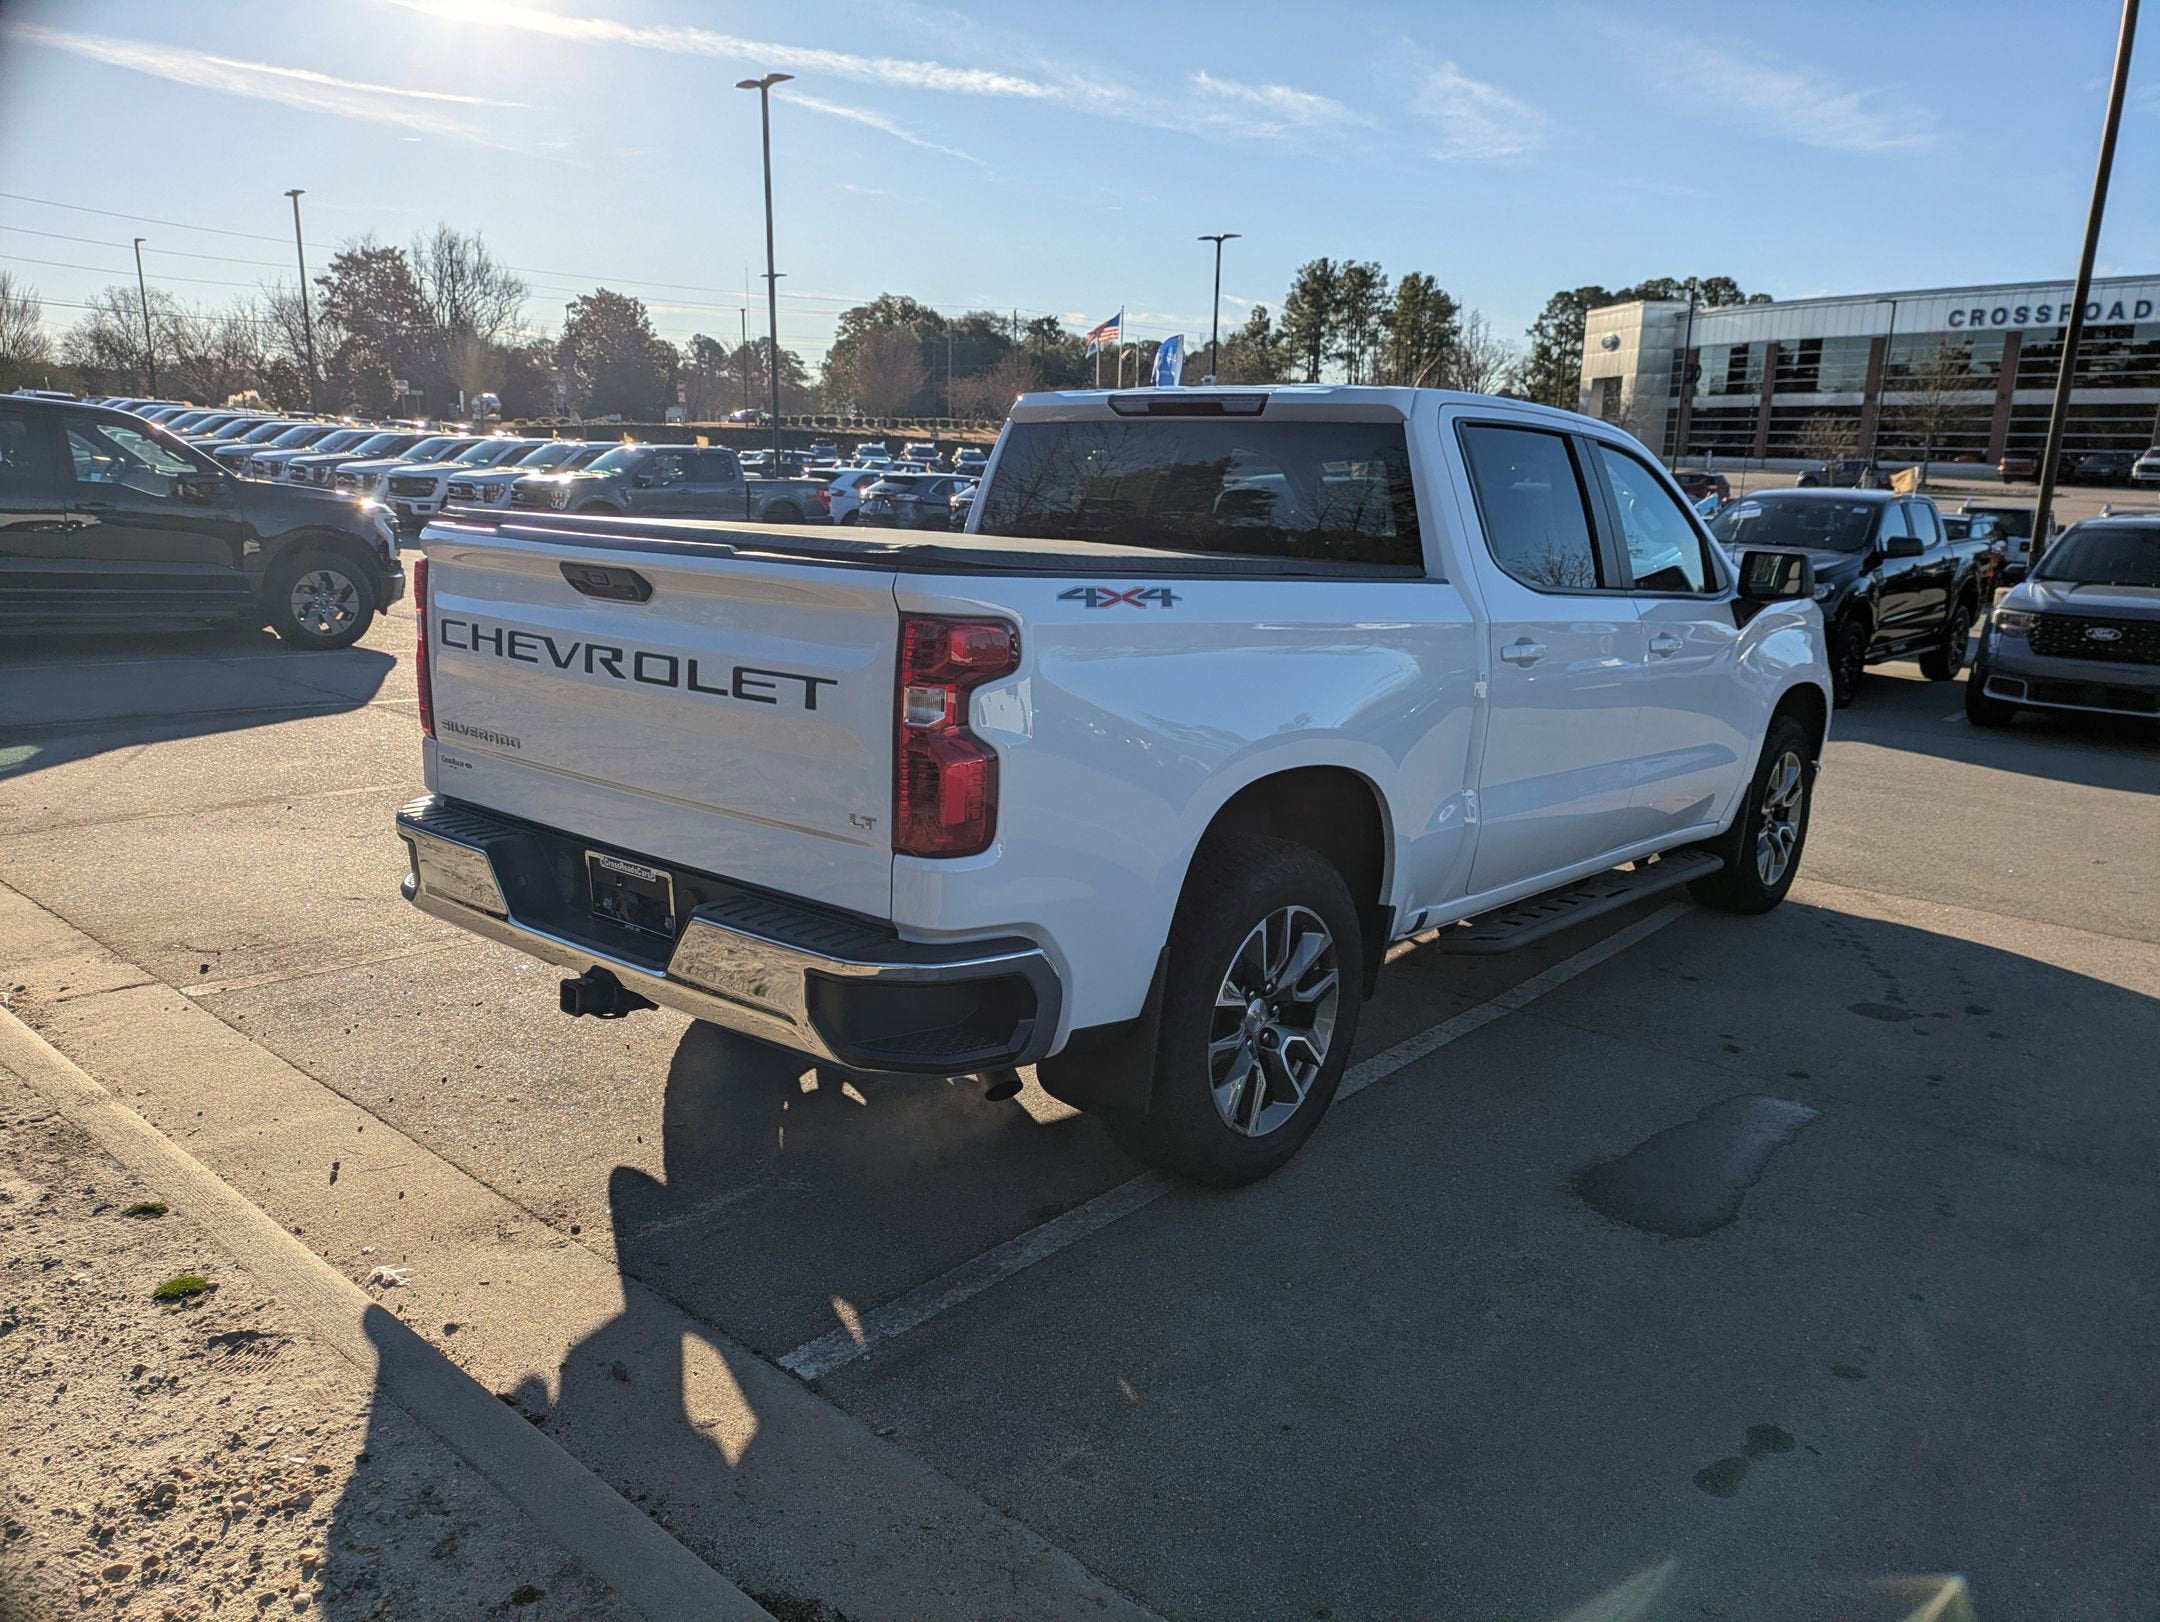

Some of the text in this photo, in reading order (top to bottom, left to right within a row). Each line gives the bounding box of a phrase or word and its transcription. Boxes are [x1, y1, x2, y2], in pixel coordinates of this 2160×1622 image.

[1948, 299, 2160, 328] CROSSROAD
[440, 618, 839, 711] CHEVROLET
[441, 719, 521, 749] SILVERADO
[848, 812, 877, 831] LT
